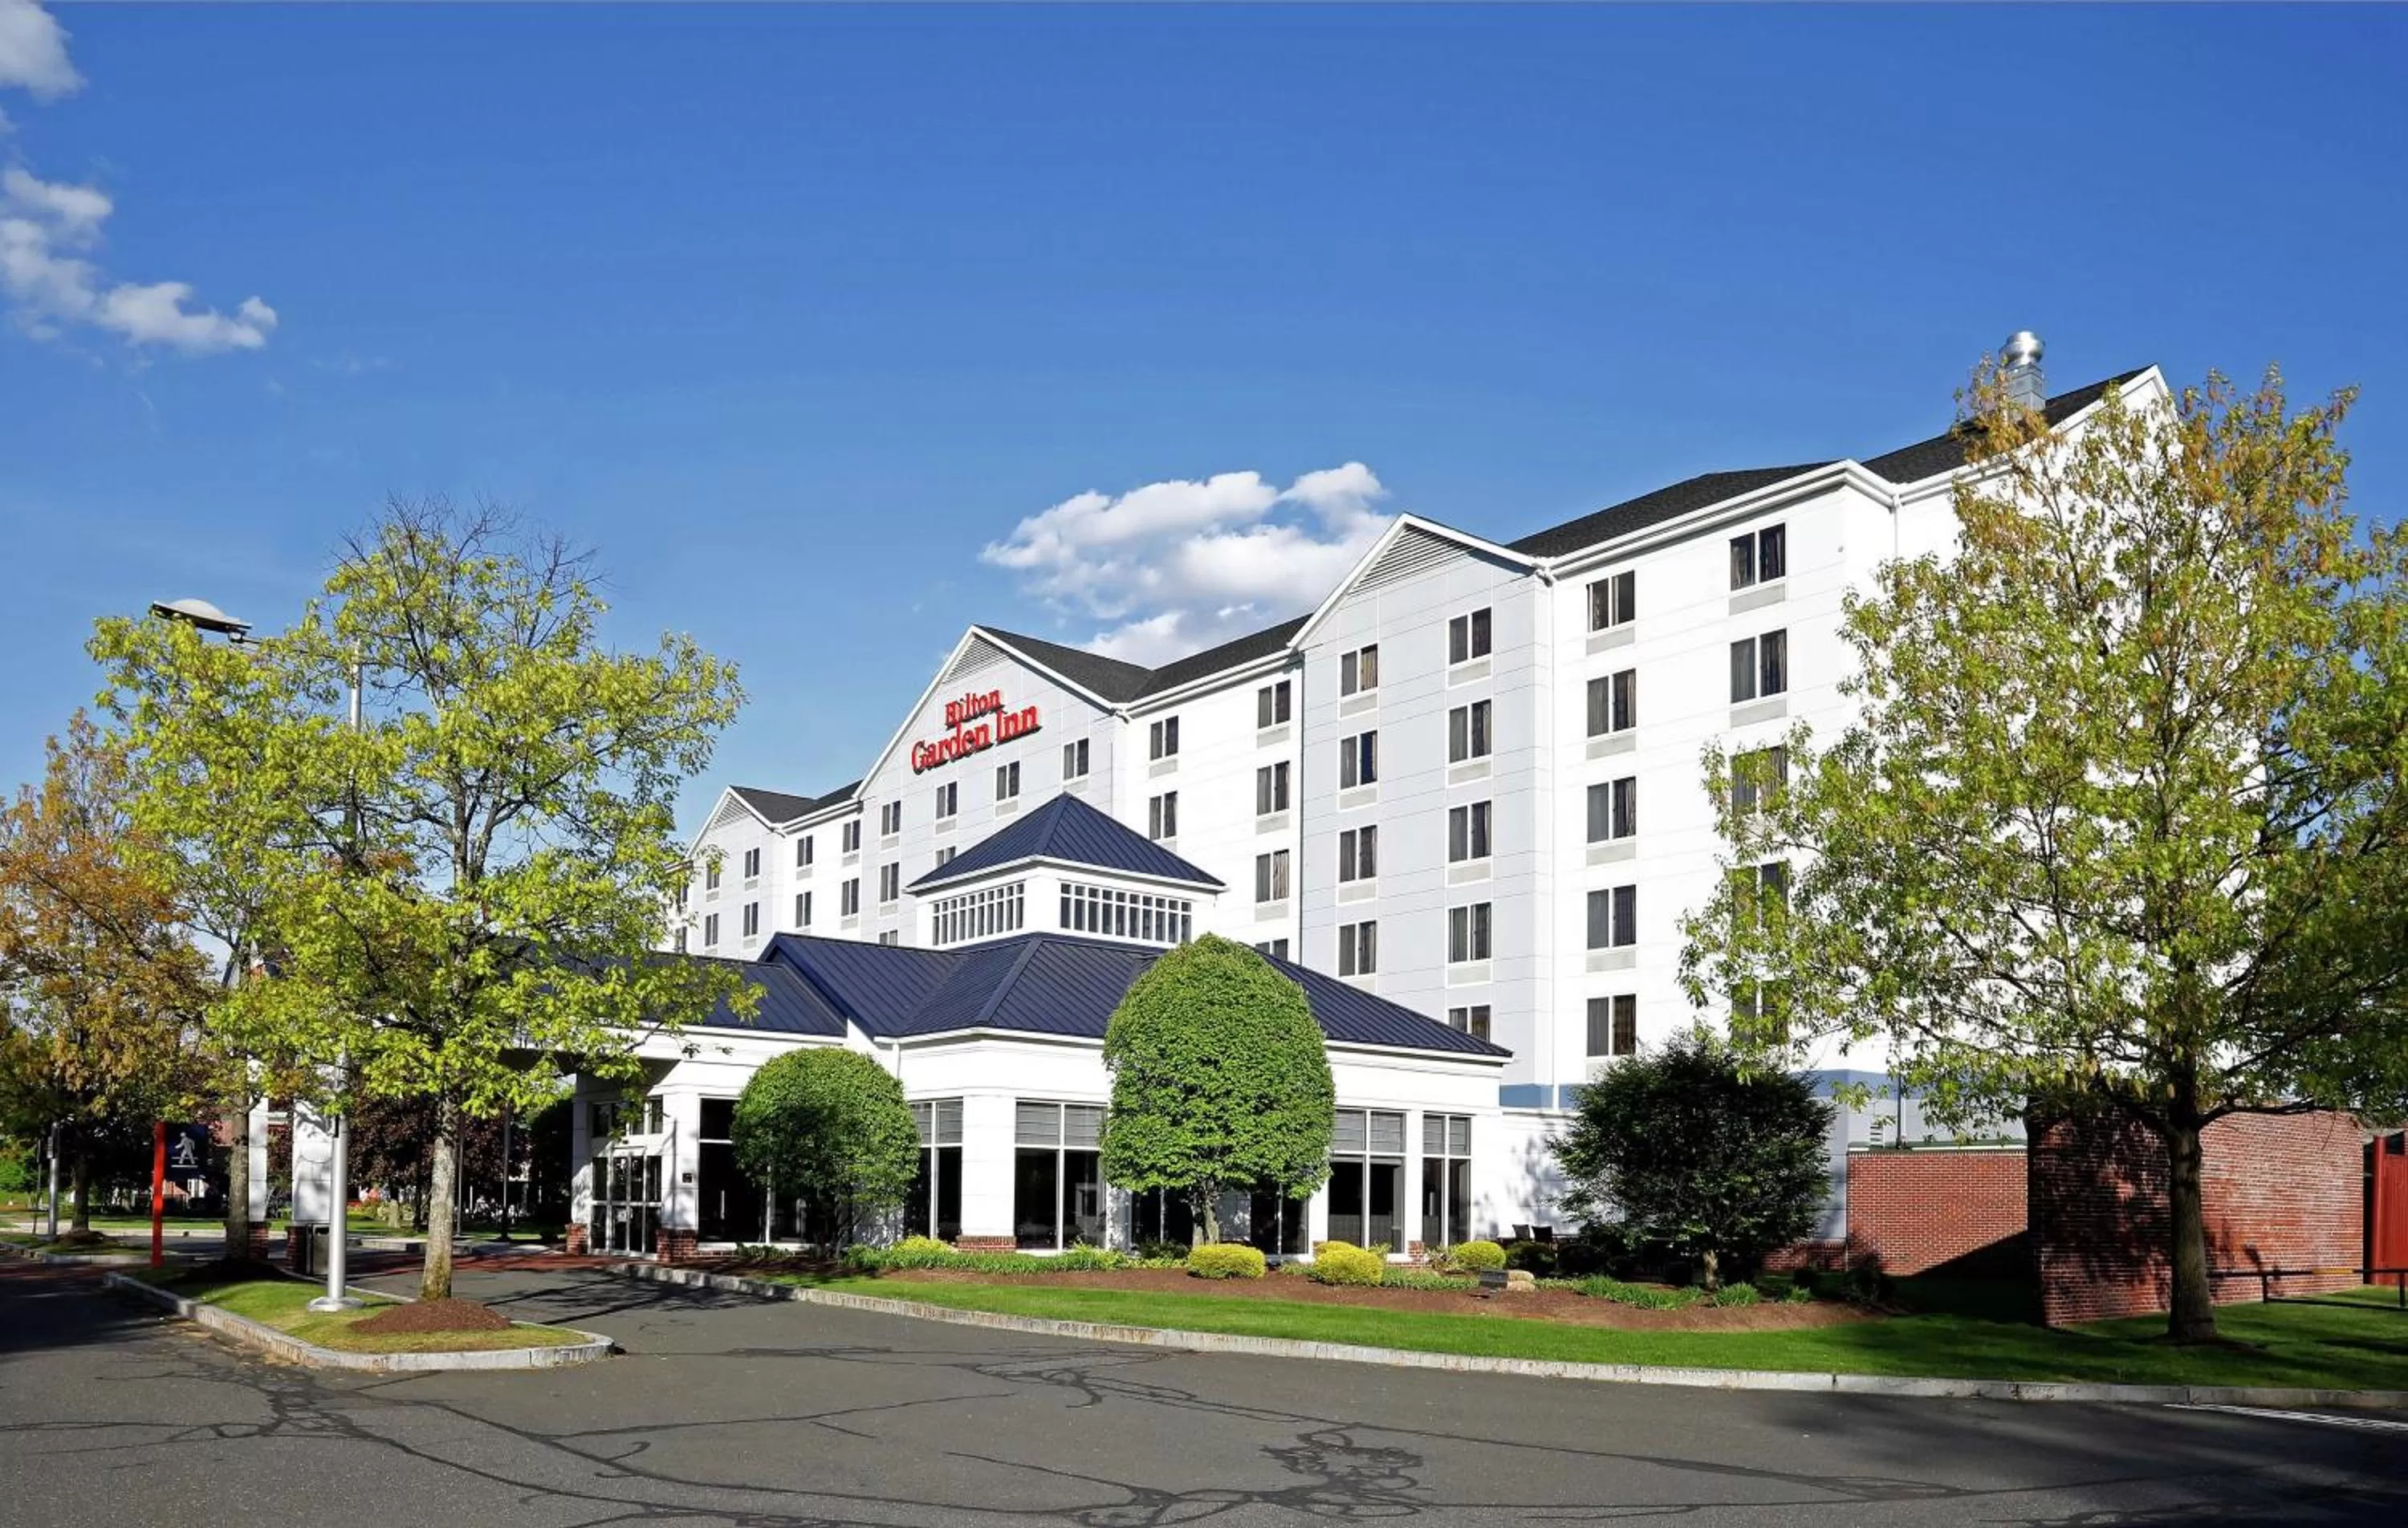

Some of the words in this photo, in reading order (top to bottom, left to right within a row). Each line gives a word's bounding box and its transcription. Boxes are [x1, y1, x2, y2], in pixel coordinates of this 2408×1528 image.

[945, 689, 1001, 725] Hilton
[911, 722, 992, 772] Garden
[995, 705, 1039, 744] Inn
